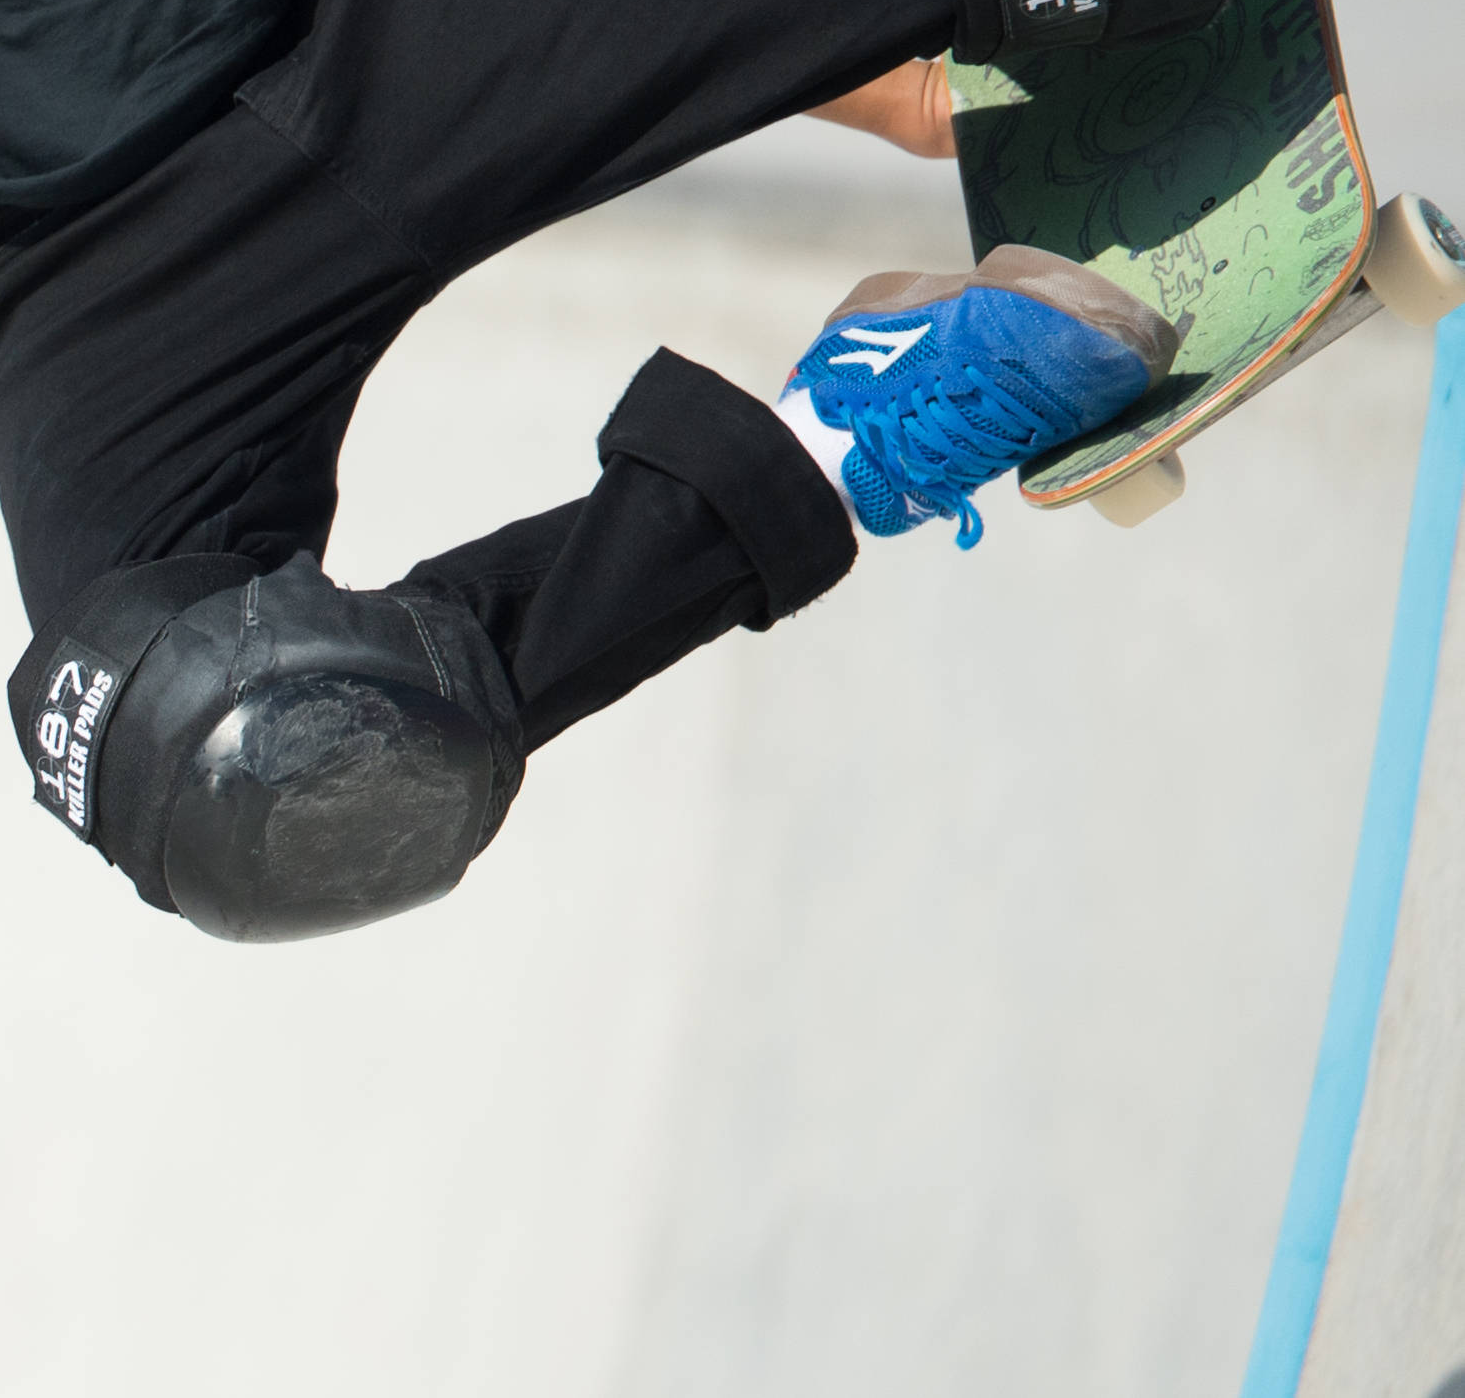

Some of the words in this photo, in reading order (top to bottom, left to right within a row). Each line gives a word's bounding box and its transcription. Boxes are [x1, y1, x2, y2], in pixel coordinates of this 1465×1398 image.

[40, 661, 84, 800] 187
[74, 669, 113, 741] PADS
[67, 740, 88, 827] KILLER
